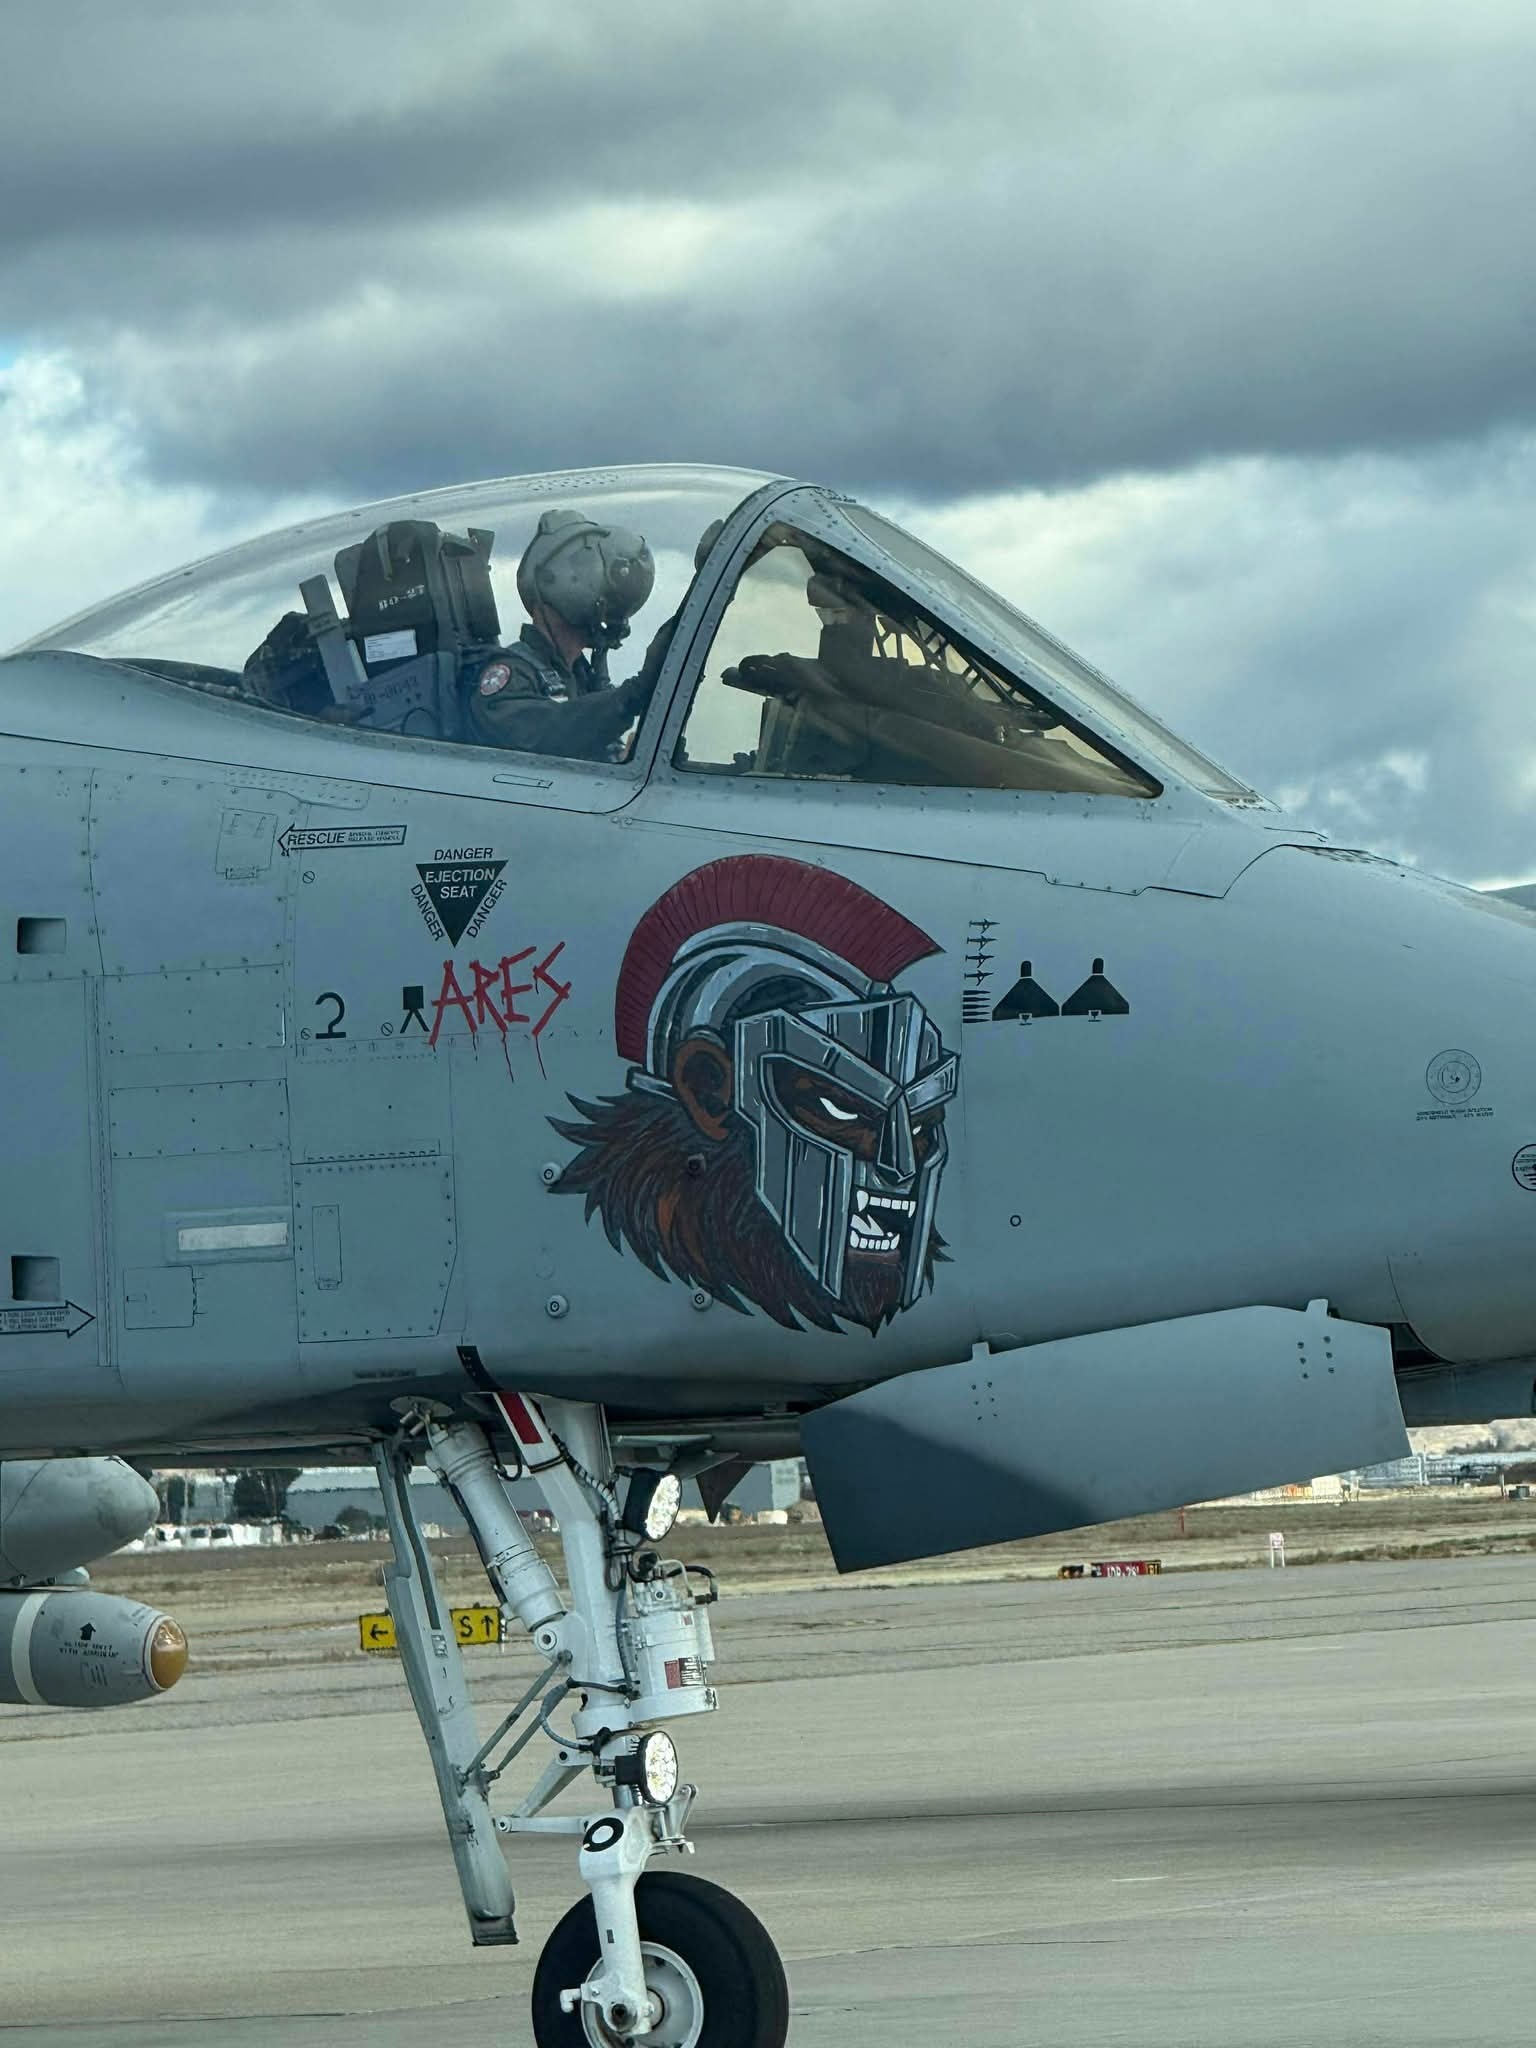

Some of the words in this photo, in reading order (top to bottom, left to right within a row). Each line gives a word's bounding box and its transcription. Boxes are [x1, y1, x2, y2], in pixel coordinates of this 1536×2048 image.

[287, 831, 346, 847] RESCUE
[434, 847, 494, 861] DANGER
[425, 868, 496, 883] EJECTION
[440, 885, 478, 899] SEAT
[411, 883, 445, 942] DANGER
[466, 879, 508, 938] DANGER
[428, 941, 572, 1048] ARES
[315, 991, 347, 1039] 2
[460, 1615, 473, 1638] S
